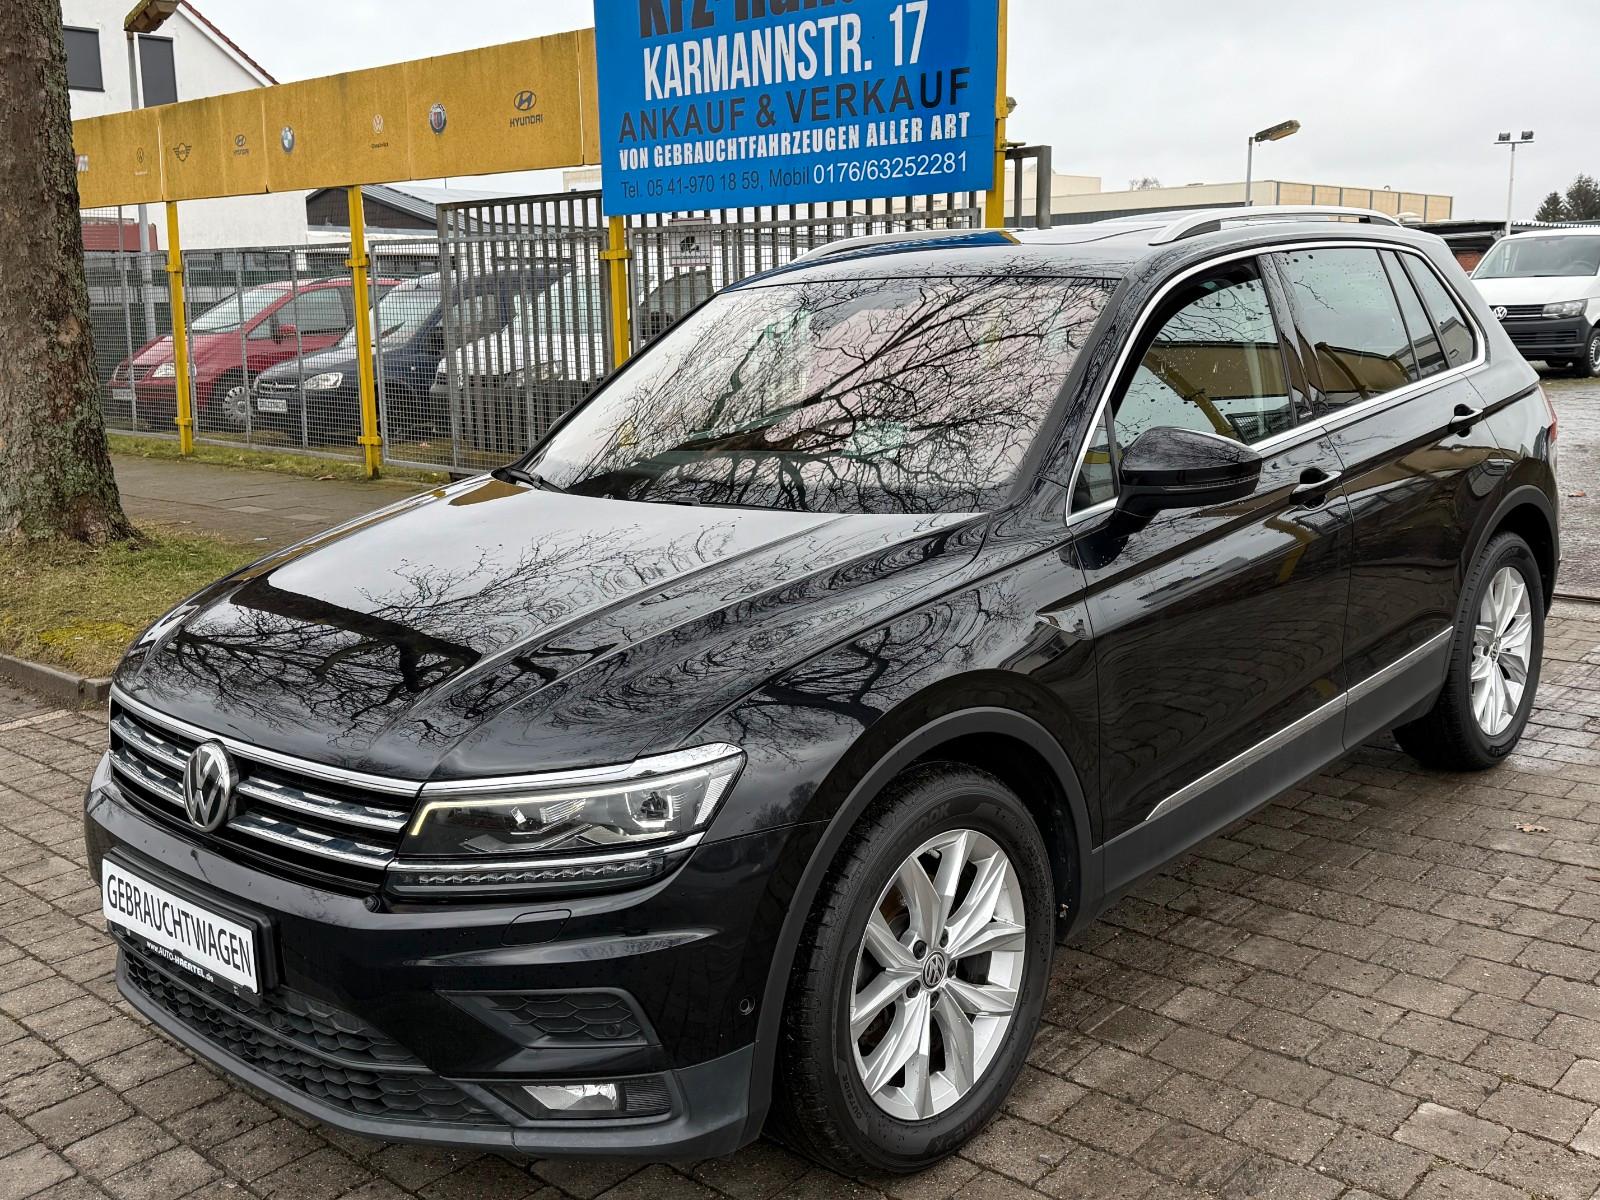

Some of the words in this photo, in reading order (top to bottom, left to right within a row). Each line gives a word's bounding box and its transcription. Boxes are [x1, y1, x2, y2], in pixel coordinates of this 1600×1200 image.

[643, 13, 872, 101] KARMANNSTR.
[889, 0, 929, 67] 17
[509, 114, 544, 128] HYUNDAI
[619, 97, 746, 144] ANKAUF
[755, 93, 777, 128] &
[785, 66, 971, 124] VERKAUF
[619, 147, 649, 171] VON
[653, 125, 860, 168] GEBRAUCHTFAHRZEUGEN
[866, 117, 923, 148] ALLER
[930, 111, 971, 141] ART
[621, 181, 643, 198] Tel.
[647, 179, 664, 197] 05
[667, 174, 715, 194] 41-970
[719, 172, 737, 191] 18
[769, 167, 810, 187] Mobil
[813, 150, 967, 185] 0176/63252281
[107, 873, 253, 978] GEBRAUCHTWAGEN
